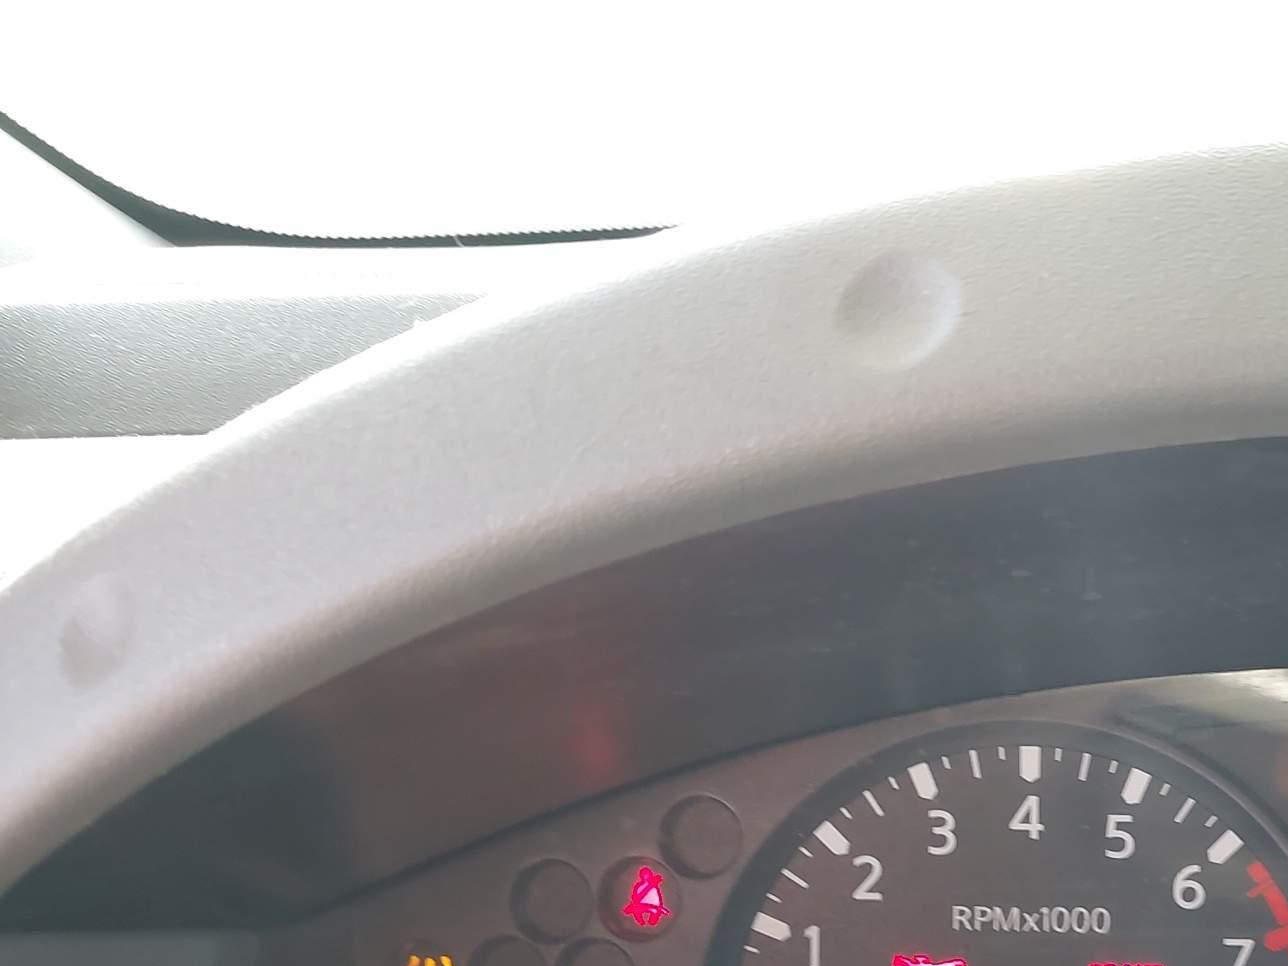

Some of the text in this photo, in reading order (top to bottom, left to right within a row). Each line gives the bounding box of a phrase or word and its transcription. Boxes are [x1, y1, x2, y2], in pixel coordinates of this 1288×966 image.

[927, 809, 957, 855] 3
[1008, 794, 1045, 840] 4
[1104, 813, 1136, 860] 5
[851, 855, 884, 901] 2
[1171, 864, 1207, 911] 6
[951, 904, 1112, 934] RPMx1000
